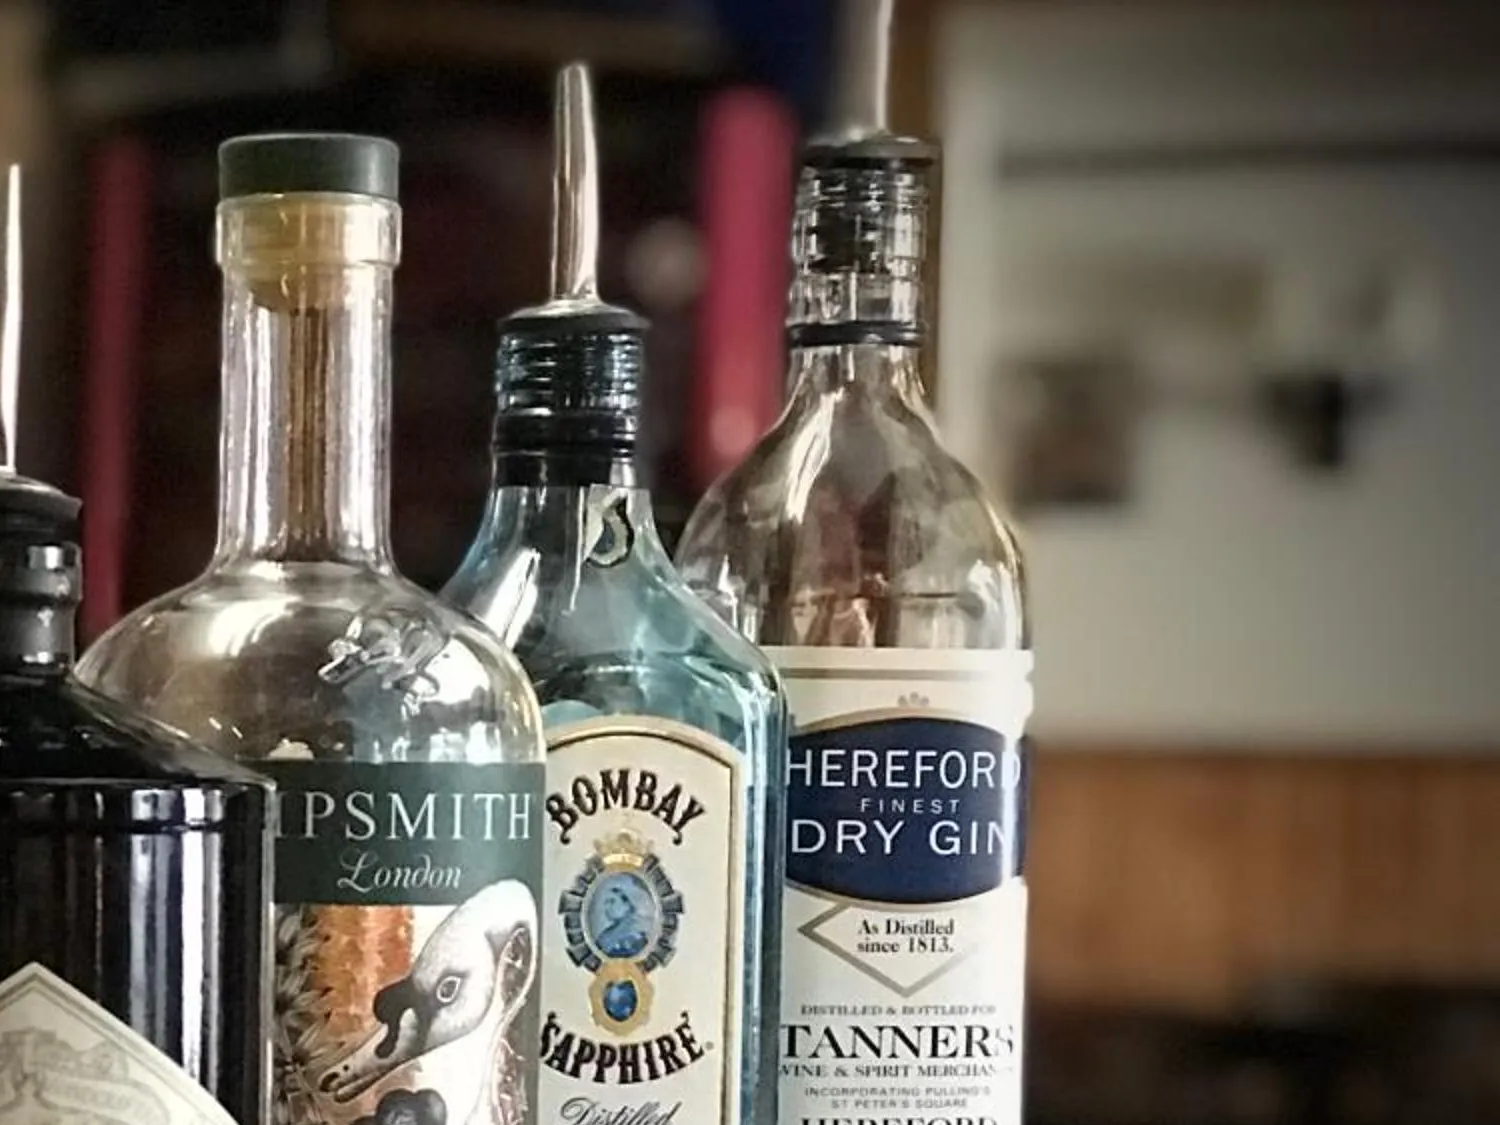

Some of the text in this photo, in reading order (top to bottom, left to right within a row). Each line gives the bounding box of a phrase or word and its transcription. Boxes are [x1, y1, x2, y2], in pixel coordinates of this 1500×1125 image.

[545, 768, 705, 846] BOMBAY
[860, 798, 961, 815] FINEST
[792, 819, 1012, 856] DRY GIN
[337, 848, 462, 893] London
[857, 919, 954, 935] As Distilled
[857, 937, 900, 952] since
[801, 1005, 882, 1016] DISTILLED
[901, 1005, 969, 1016] BOTTLED
[540, 1011, 705, 1085] SAPPHIRE
[780, 1024, 1014, 1059] TANNERS
[833, 1064, 849, 1078] &
[855, 1064, 910, 1078] SPIRIT
[805, 1086, 920, 1097] INCORPORATING
[916, 1099, 967, 1109] SQUARE
